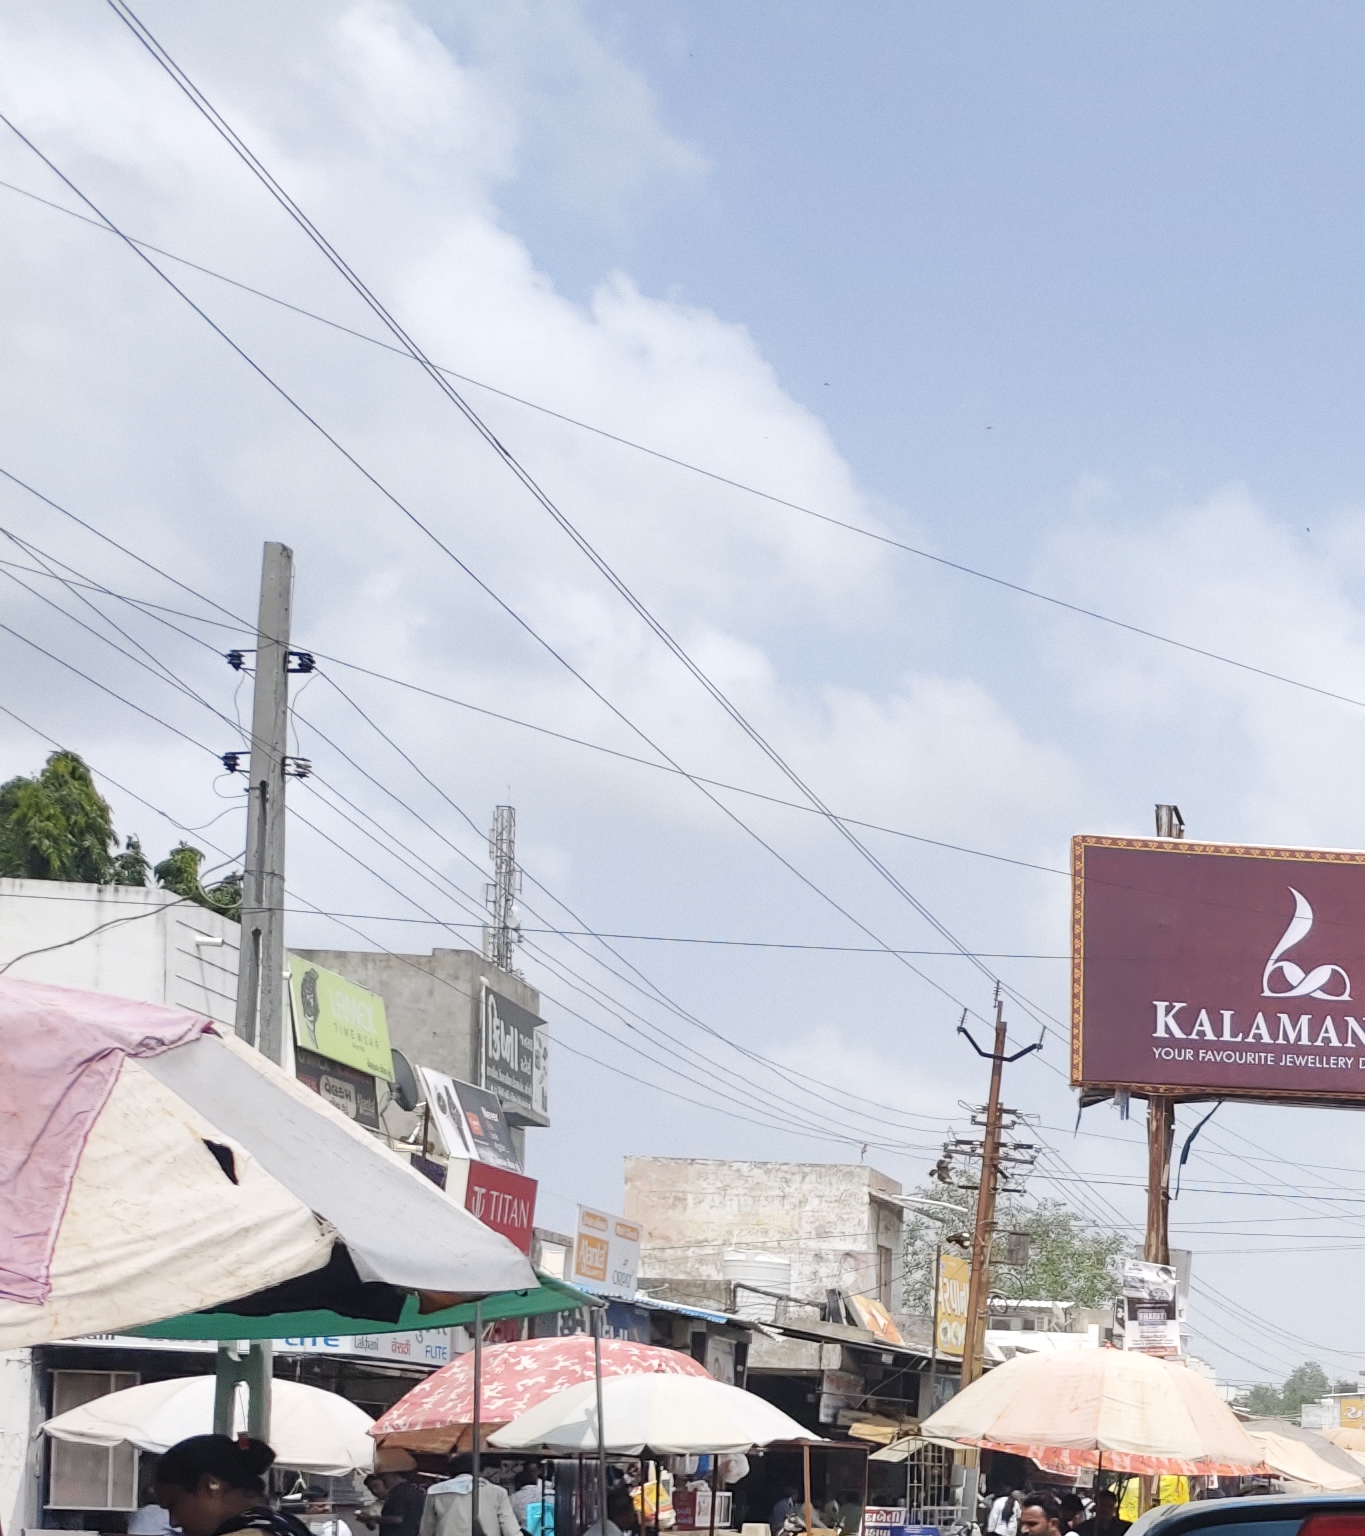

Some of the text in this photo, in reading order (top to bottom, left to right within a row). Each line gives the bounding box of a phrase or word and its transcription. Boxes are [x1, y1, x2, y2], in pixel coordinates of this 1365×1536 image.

[1153, 1046, 1195, 1061] YOUR
[1198, 1048, 1275, 1066] FAVOURITE
[1279, 1053, 1354, 1070] JEWELLERY
[489, 1190, 530, 1229] TITAN
